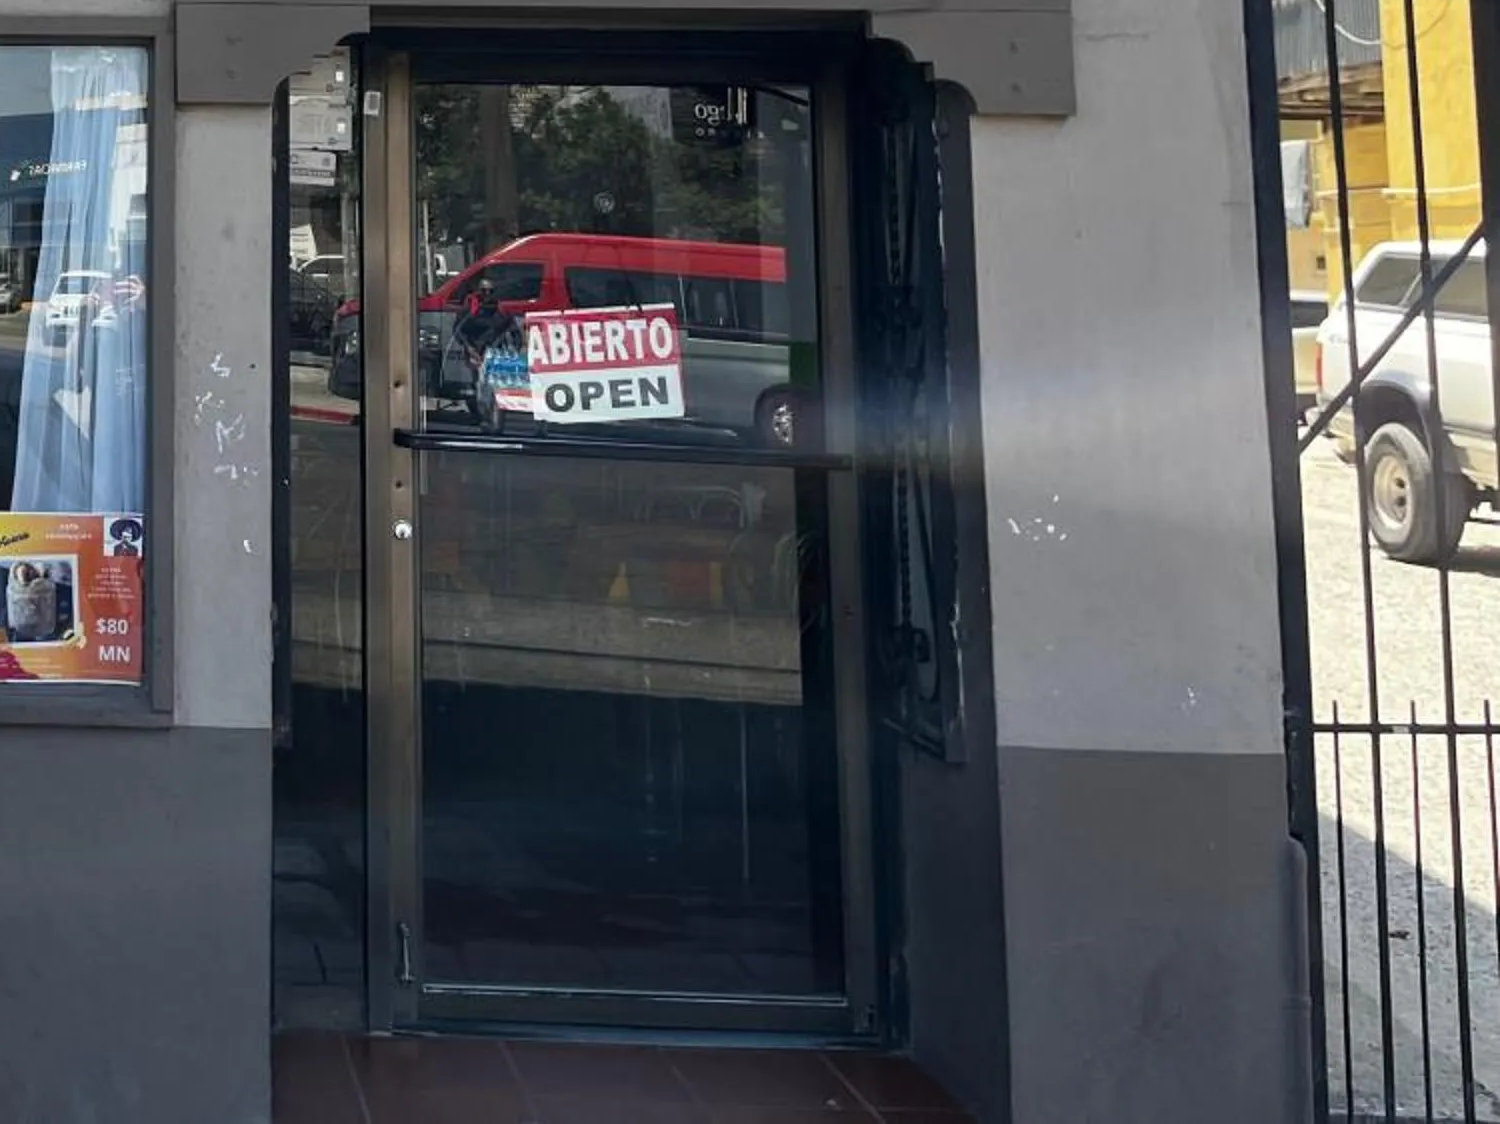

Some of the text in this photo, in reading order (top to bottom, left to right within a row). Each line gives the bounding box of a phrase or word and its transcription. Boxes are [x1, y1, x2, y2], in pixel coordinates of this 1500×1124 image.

[528, 317, 673, 366] ABIERTO
[545, 377, 669, 413] OPEN
[96, 618, 129, 635] $80
[99, 645, 131, 662] MN
